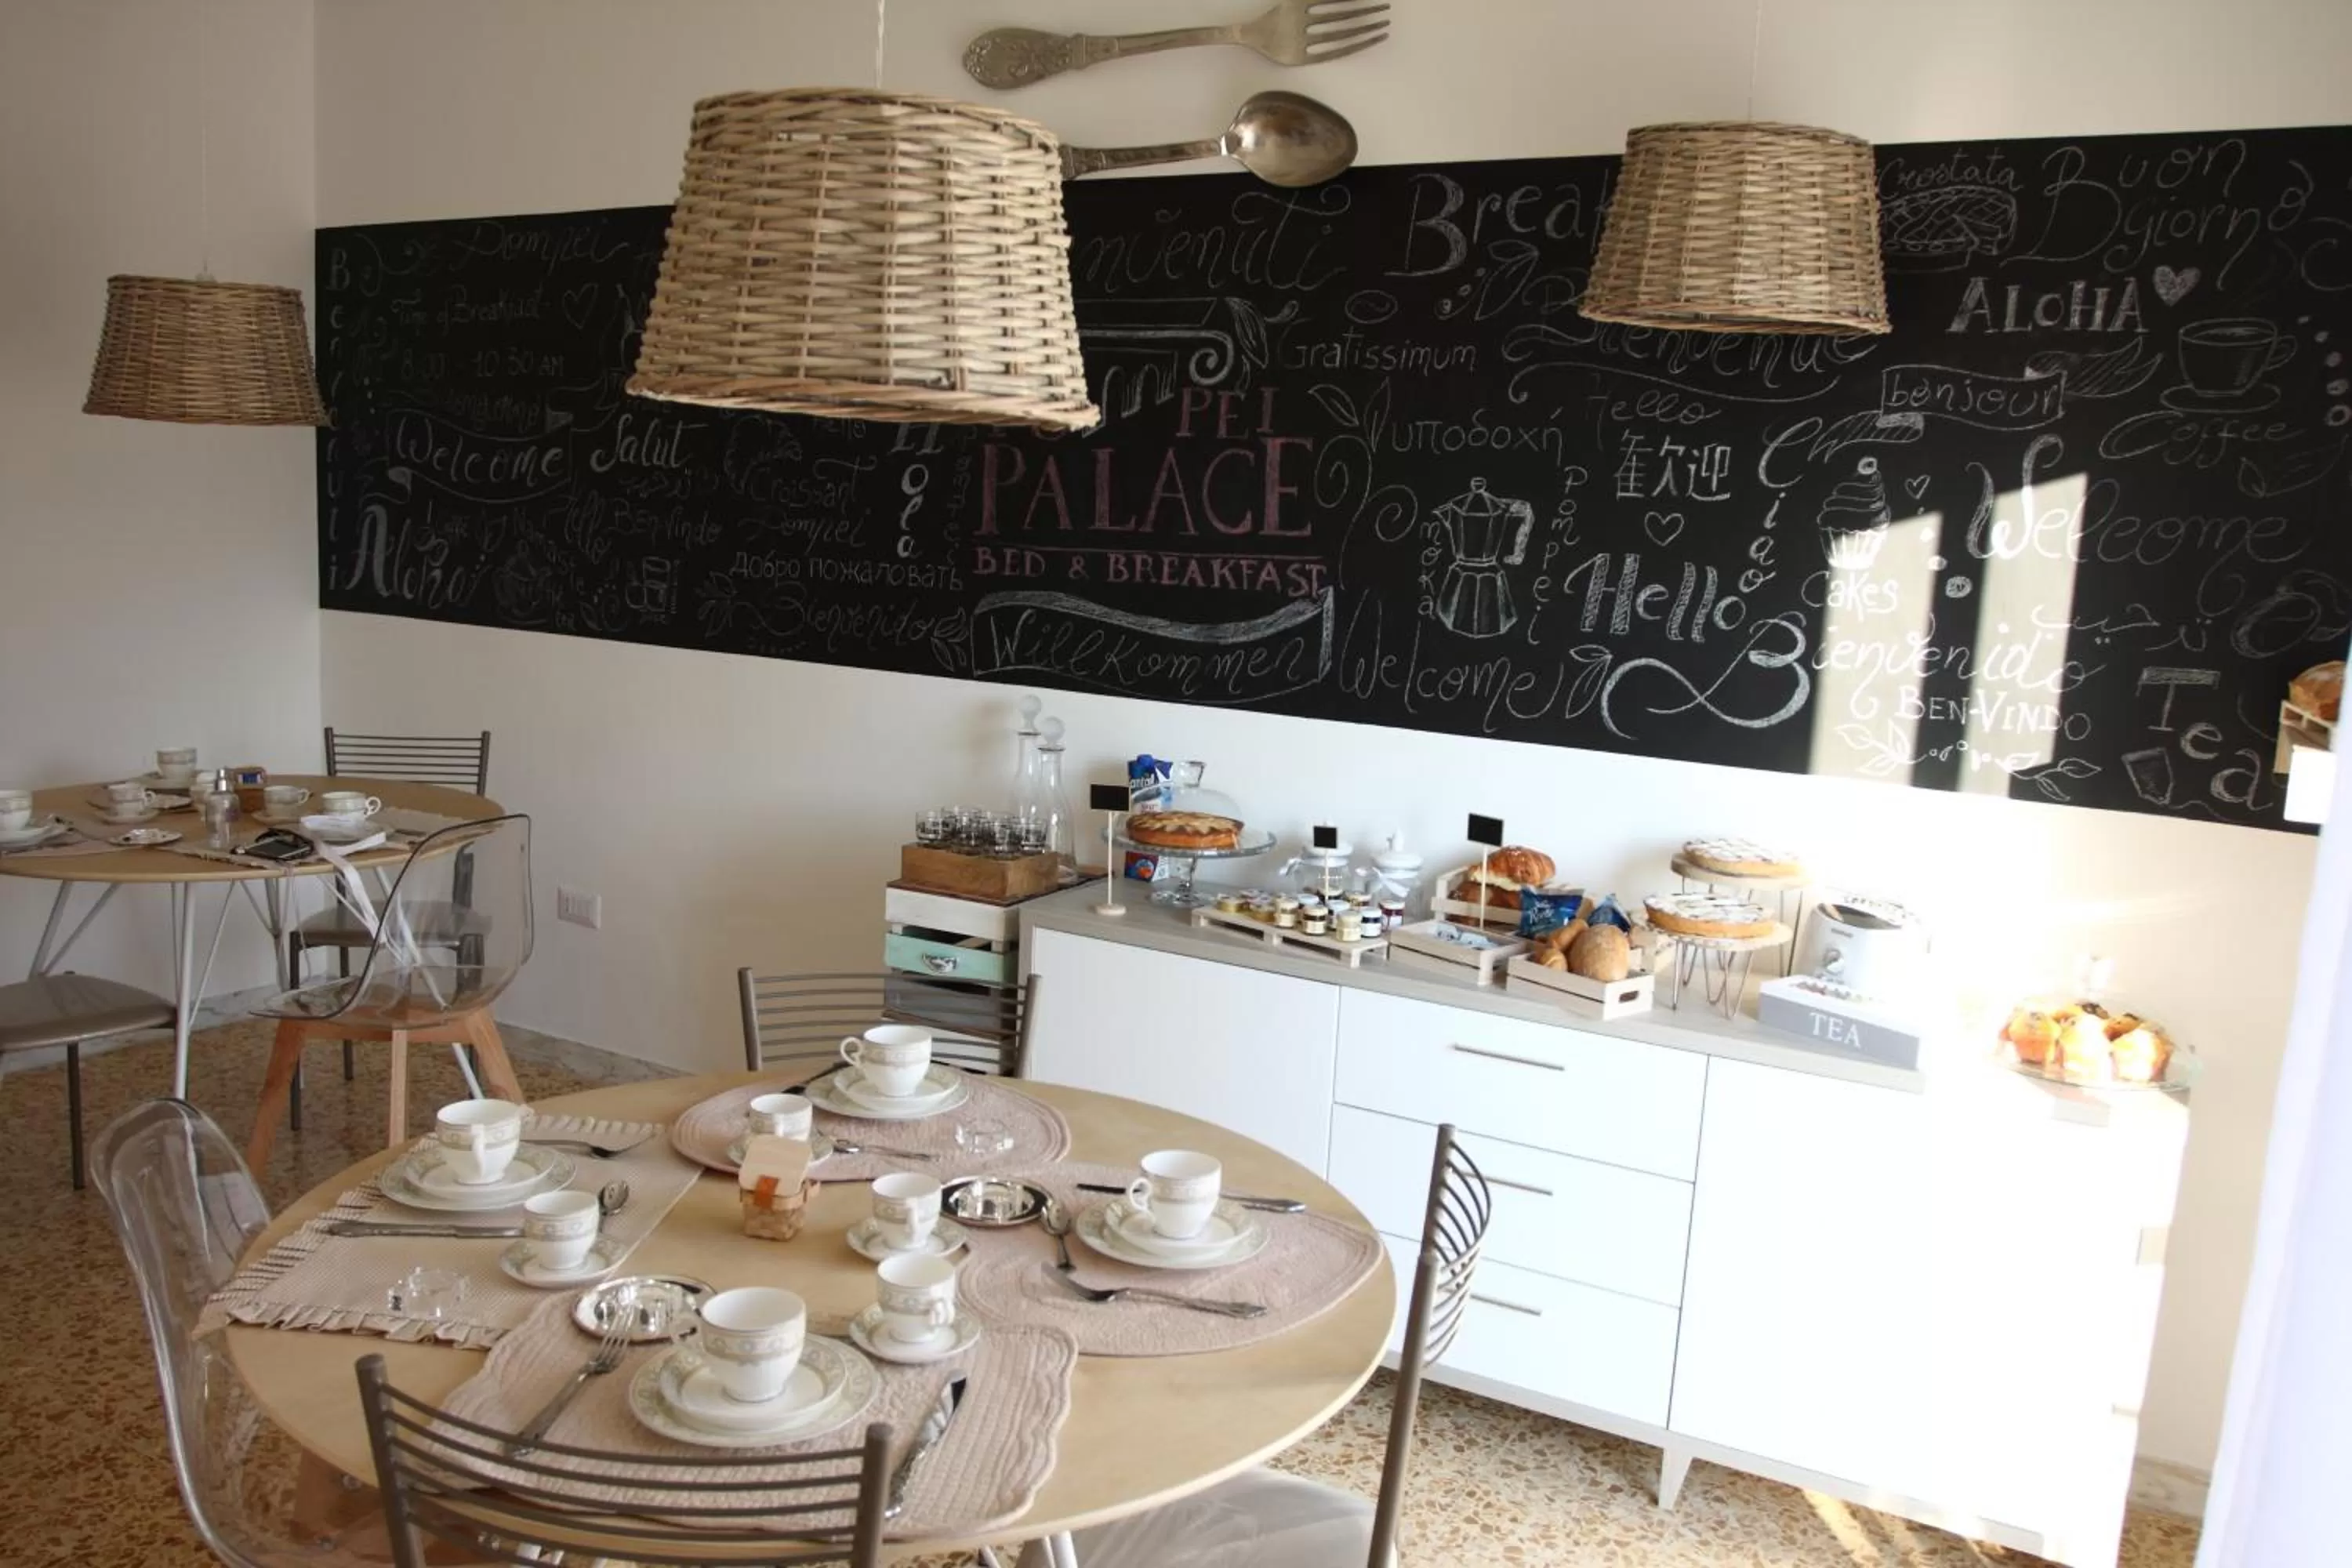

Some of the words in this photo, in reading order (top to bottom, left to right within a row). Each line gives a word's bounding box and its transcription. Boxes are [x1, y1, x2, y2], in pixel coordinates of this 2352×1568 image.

[1074, 185, 1352, 293] nvenuti
[1946, 276, 2150, 334] ALOHA
[396, 416, 565, 488] Welcome
[971, 434, 1316, 538] PALACE
[972, 547, 1047, 579] BED
[1106, 551, 1330, 601] BREAKFAST
[1564, 552, 1747, 644] Hello
[1338, 588, 1565, 733] Welcome
[1809, 1012, 1861, 1049] TEA
